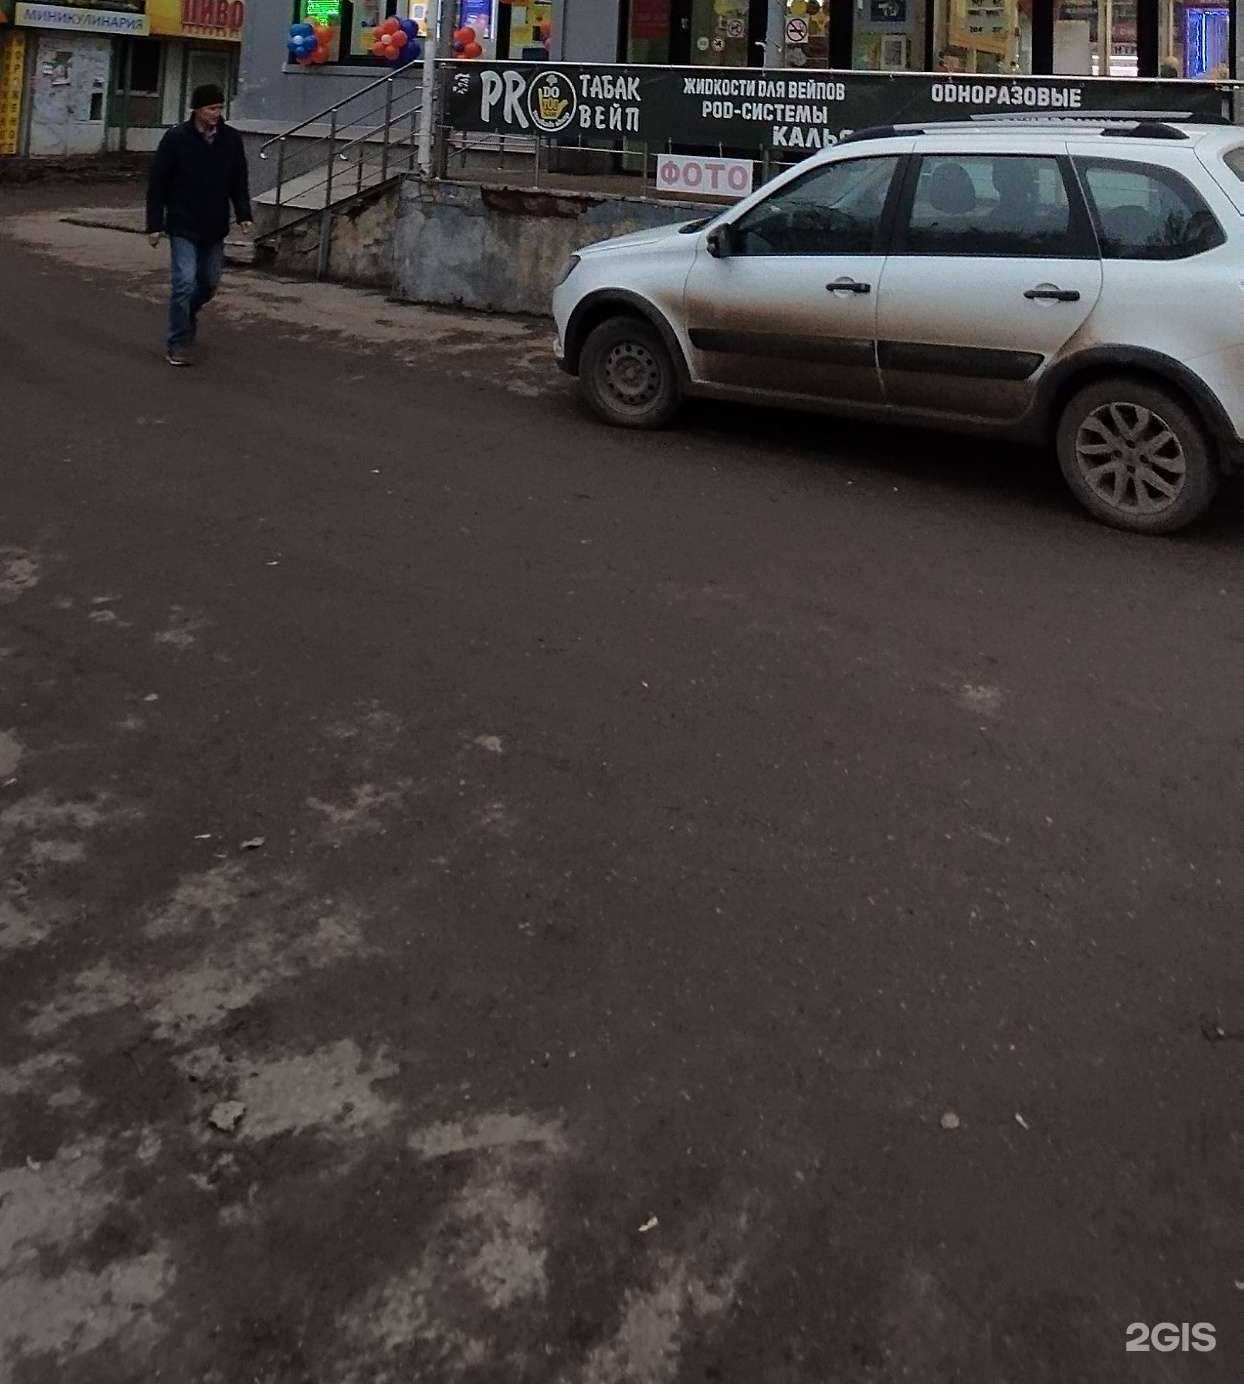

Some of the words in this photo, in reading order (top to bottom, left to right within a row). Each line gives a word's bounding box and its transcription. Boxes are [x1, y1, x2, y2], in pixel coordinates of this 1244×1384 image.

[578, 73, 642, 102] ТАБАК
[788, 79, 845, 101] ВЕЙПОВ
[578, 102, 641, 133] ВЕЙП
[661, 160, 748, 191] ФОТО
